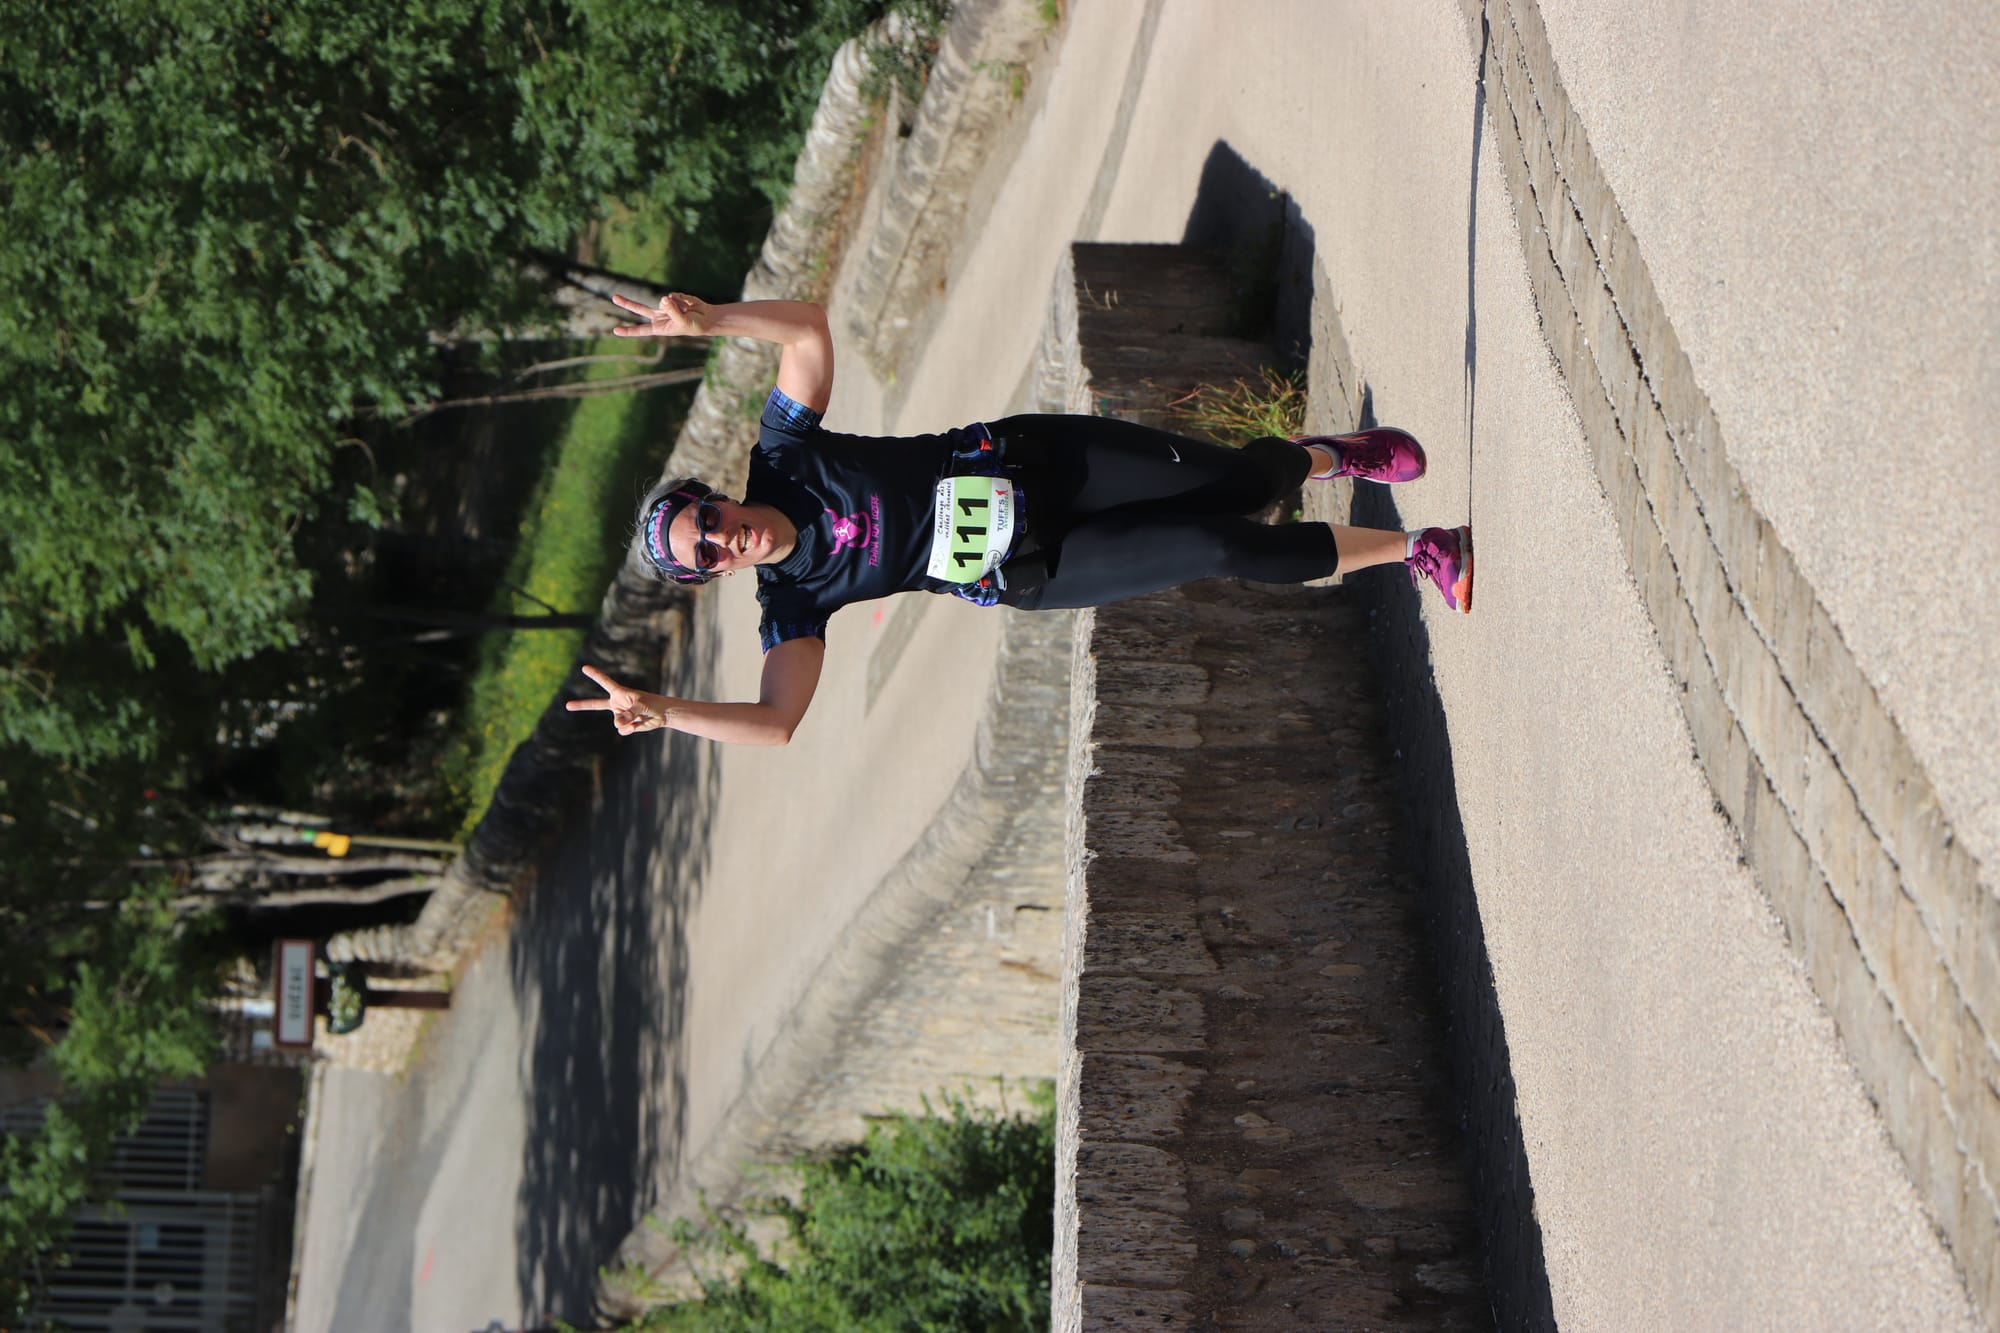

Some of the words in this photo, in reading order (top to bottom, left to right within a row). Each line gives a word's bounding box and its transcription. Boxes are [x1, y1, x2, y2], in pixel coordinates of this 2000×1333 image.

[648, 500, 669, 558] KASTA
[871, 523, 880, 538] RUN
[953, 498, 989, 568] 111
[868, 541, 879, 566] FEMINA
